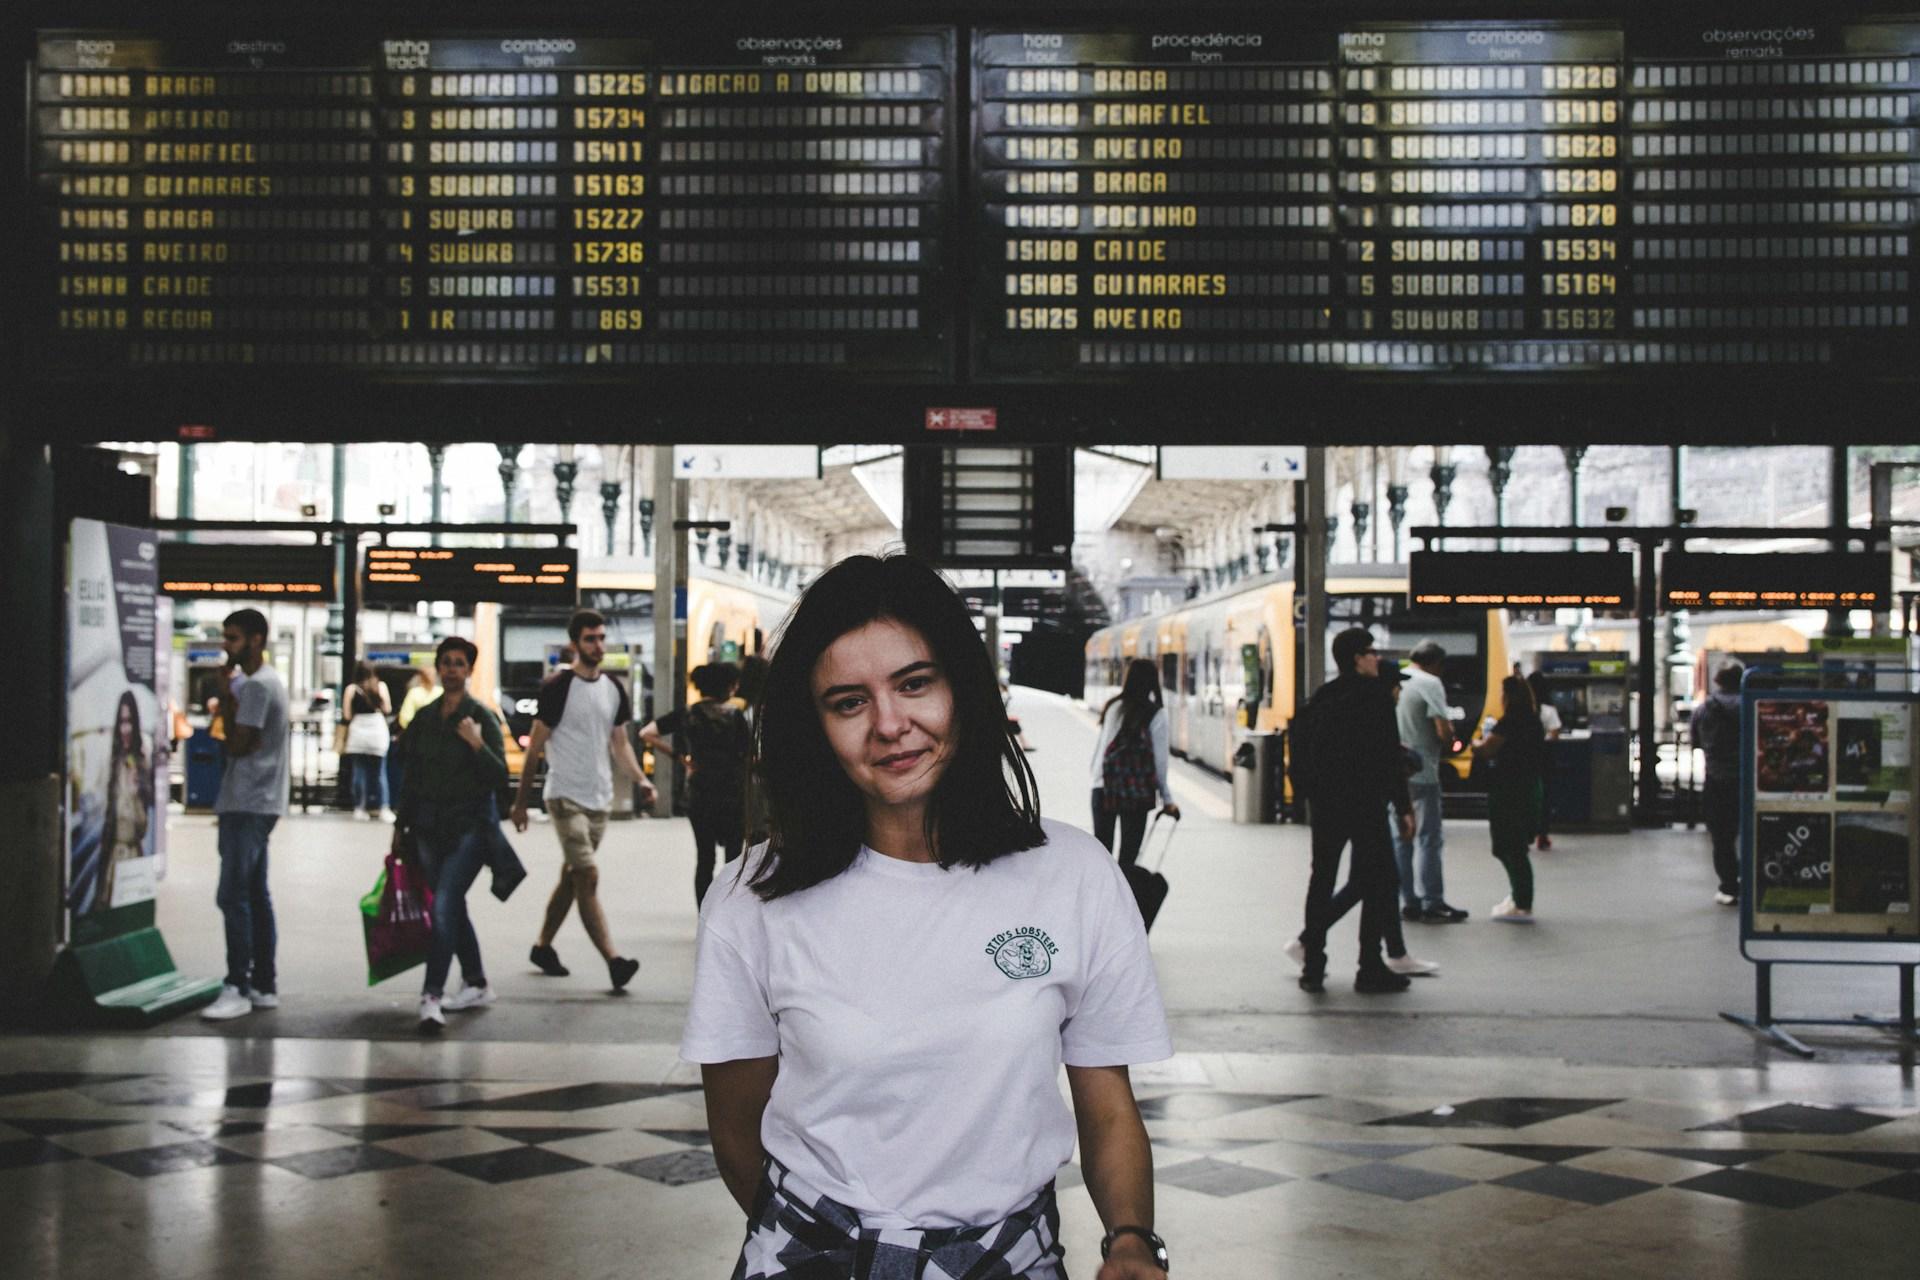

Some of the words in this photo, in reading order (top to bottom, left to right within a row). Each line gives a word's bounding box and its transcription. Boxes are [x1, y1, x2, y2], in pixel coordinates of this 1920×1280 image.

[500, 38, 575, 54] comboio
[737, 36, 843, 52] observações
[1022, 33, 1063, 49] hora
[1151, 33, 1262, 50] procedência
[1343, 32, 1386, 47] linha
[1466, 29, 1545, 46] comboio
[1702, 27, 1816, 45] observações
[384, 40, 430, 55] linha
[1725, 45, 1784, 58] remarks
[145, 75, 215, 96] BRAGA
[430, 74, 515, 96] SUBURB
[574, 73, 645, 95] 15225
[660, 73, 760, 96] LIGACAO
[776, 73, 789, 93] A
[805, 72, 863, 93] OVAR
[1093, 69, 1168, 92] BRAGA
[1391, 67, 1481, 90] SUBURB
[1542, 66, 1617, 90] 15226
[402, 109, 416, 130] 3
[430, 108, 515, 130] SUBURB
[574, 108, 645, 129] 15734
[1093, 103, 1211, 126] PENAFIEL
[1361, 102, 1375, 125] 3
[1391, 102, 1481, 124] SUBURB
[1542, 100, 1617, 124] 15416
[144, 142, 256, 163] PENAFIEL
[402, 142, 415, 163] 1
[430, 142, 515, 163] SUBURB
[574, 141, 642, 162] 15411
[1006, 137, 1079, 160] 14H25
[1093, 137, 1183, 160] AVEIRO
[1391, 135, 1481, 159] SUBURB
[1542, 135, 1617, 158] 15628
[144, 175, 272, 196] GUIMARAES
[401, 175, 415, 196] 3
[429, 175, 514, 196] SUBURB
[574, 175, 644, 196] 15163
[1093, 171, 1168, 194] BRAGA
[1361, 171, 1375, 193] 5
[1391, 169, 1481, 193] SUBURB
[60, 209, 129, 229] 14H45
[144, 209, 214, 229] BRAGA
[402, 208, 411, 229] 1
[429, 208, 514, 230] SUBURB
[573, 208, 645, 229] 15227
[1093, 205, 1197, 228] POCINHO
[1571, 204, 1617, 227] 870
[60, 242, 128, 262] 14H55
[144, 242, 228, 262] AVEIRO
[400, 243, 413, 263] 4
[429, 242, 514, 263] SUBURB
[572, 242, 643, 263] 15736
[1005, 240, 1079, 262] 15H00
[1093, 240, 1167, 262] CAIDE
[1361, 240, 1376, 262] 2
[1391, 240, 1480, 262] SUBURB
[1542, 239, 1616, 261] 15534
[143, 276, 212, 296] CAIDE
[400, 276, 412, 296] 5
[428, 276, 513, 296] SUBURB
[572, 276, 640, 296] 15531
[1005, 274, 1079, 296] 15H05
[1093, 274, 1227, 296] GUIMARAES
[1361, 274, 1375, 296] 5
[1391, 274, 1480, 296] SUBURB
[1542, 273, 1616, 296] 15164
[60, 309, 127, 329] 15H10
[143, 309, 213, 329] REGUA
[400, 310, 409, 330] 1
[430, 309, 455, 330] IR
[599, 309, 642, 330] 869
[1005, 308, 1078, 330] 15H25
[1093, 308, 1182, 330] AVEIRO
[1391, 308, 1480, 330] SUBURB
[1542, 308, 1616, 330] 15632
[984, 929, 1014, 956] OTTO'S
[1014, 926, 1060, 956] LOBSTERS
